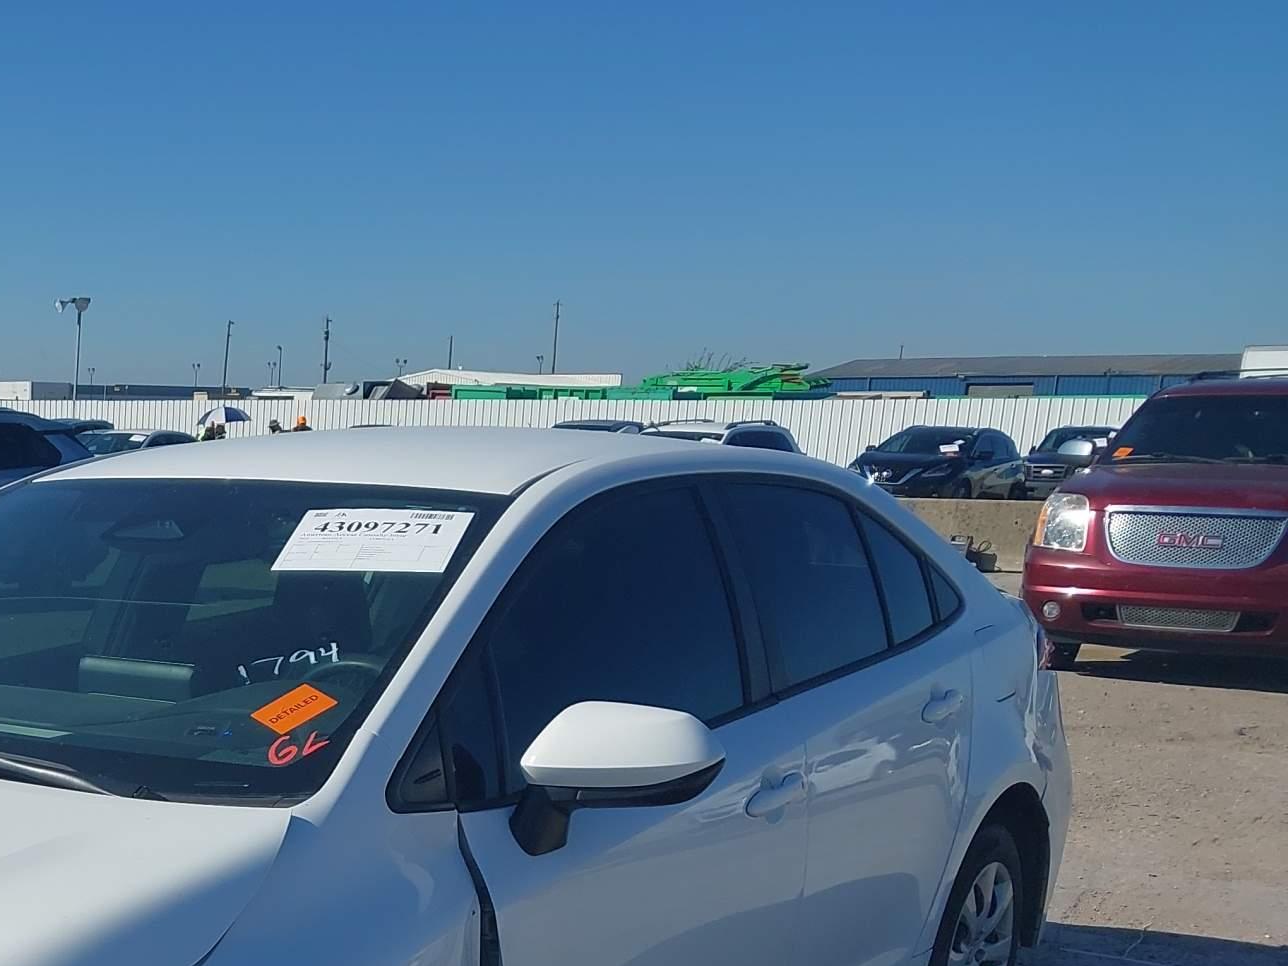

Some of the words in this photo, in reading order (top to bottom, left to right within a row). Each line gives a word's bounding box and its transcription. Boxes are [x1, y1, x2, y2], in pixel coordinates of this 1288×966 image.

[314, 521, 443, 535] 43097271
[1157, 533, 1224, 550] GMC
[237, 642, 340, 685] 1794
[268, 694, 320, 725] DETAILED
